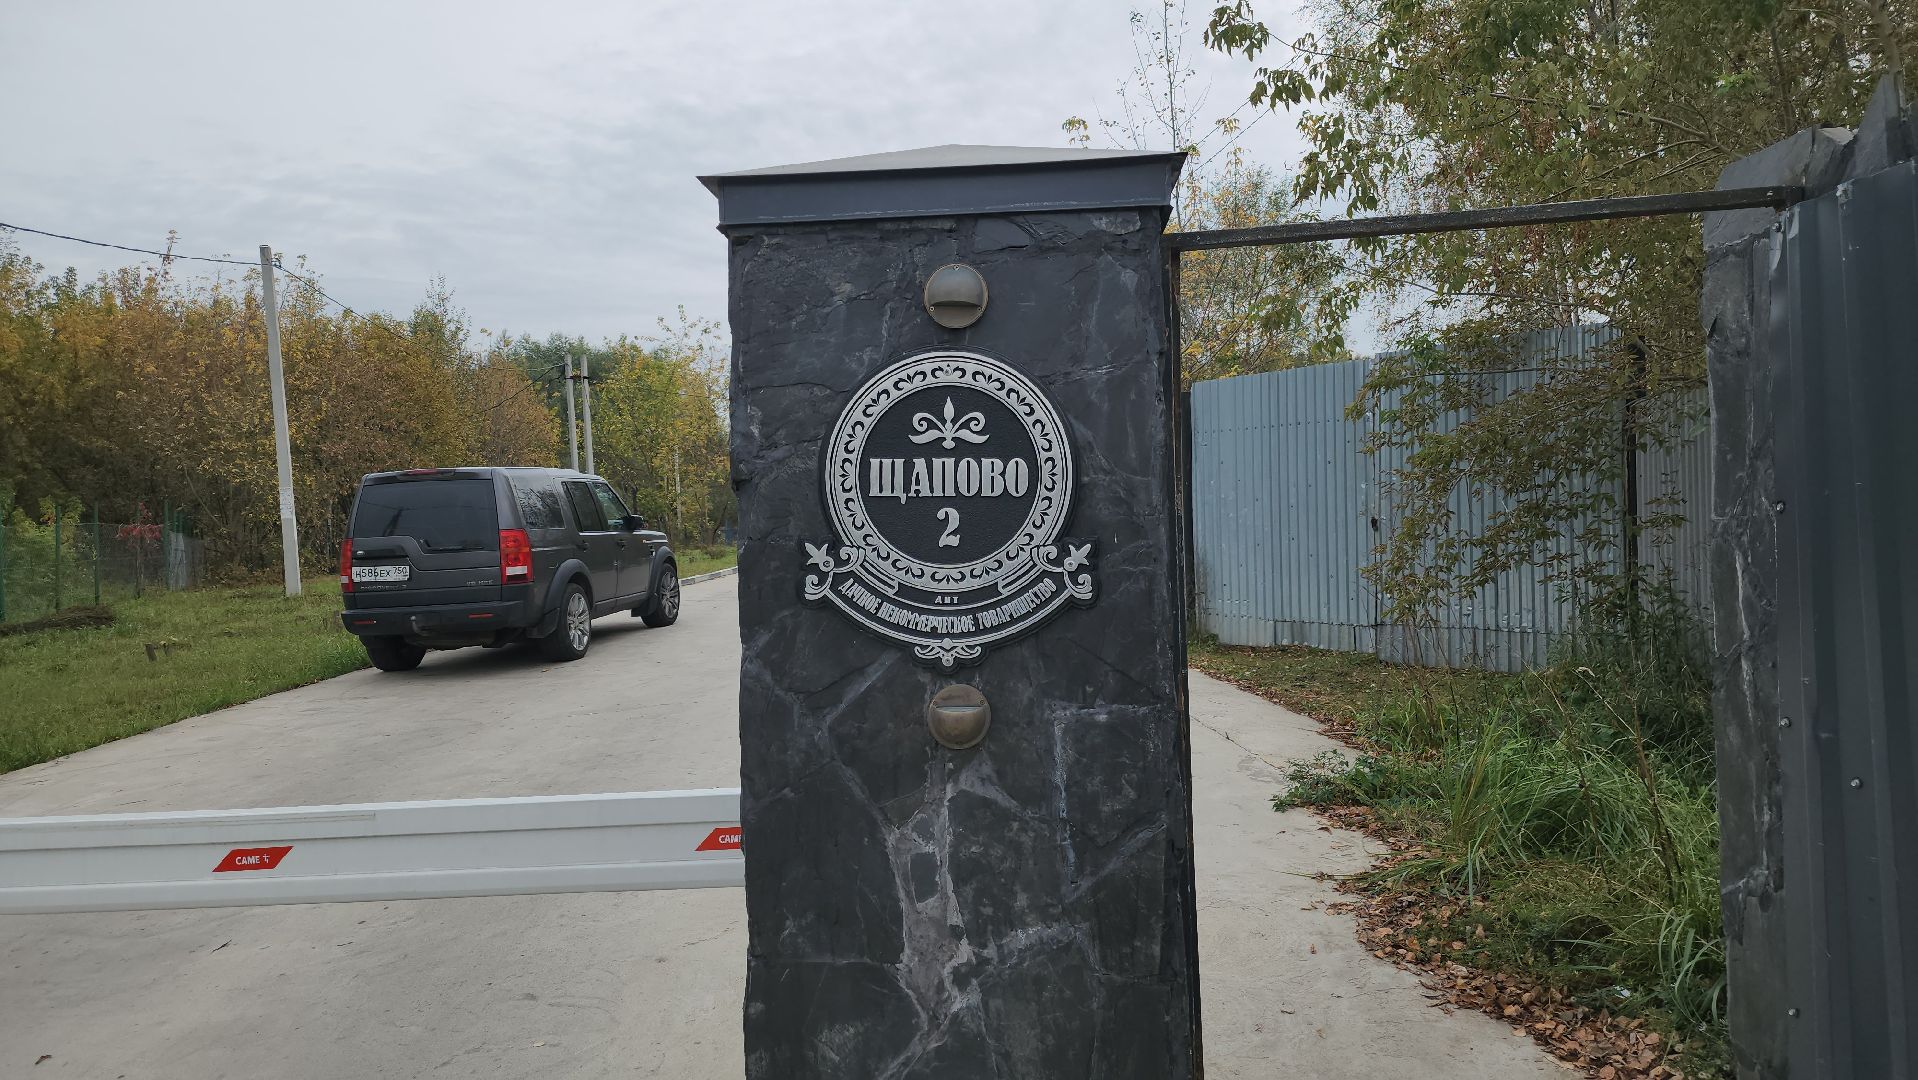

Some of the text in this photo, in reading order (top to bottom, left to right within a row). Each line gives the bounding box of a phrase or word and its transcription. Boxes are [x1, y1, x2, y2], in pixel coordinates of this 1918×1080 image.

[868, 457, 1029, 504] ЩАПОВО
[936, 507, 961, 548] 2
[392, 566, 408, 575] 750
[837, 577, 1057, 634] ДАЧНОЕ НЕКОММЕРЧЕСКОЕ ТОВАРИЩЕСТВО
[235, 855, 261, 865] CAME
